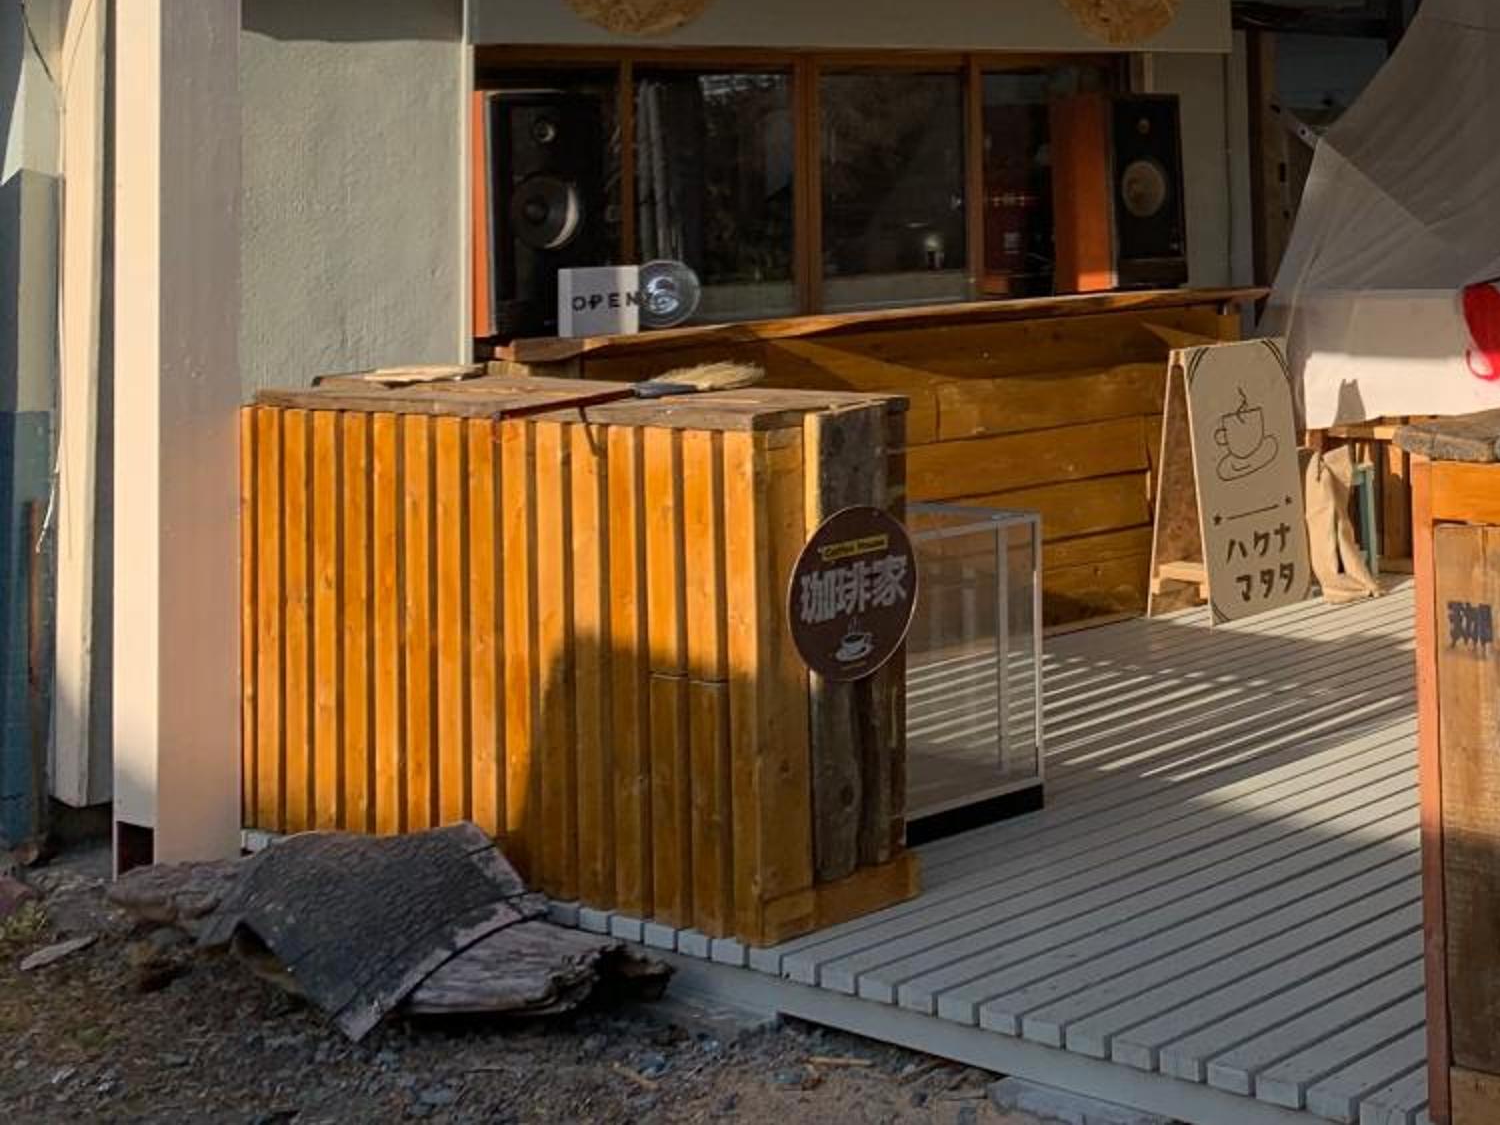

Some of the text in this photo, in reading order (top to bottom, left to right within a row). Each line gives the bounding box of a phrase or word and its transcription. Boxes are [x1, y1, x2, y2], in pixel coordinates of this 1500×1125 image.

[571, 289, 644, 313] OPEN
[1226, 522, 1291, 563] ハクナ
[1236, 563, 1294, 601] マタタ
